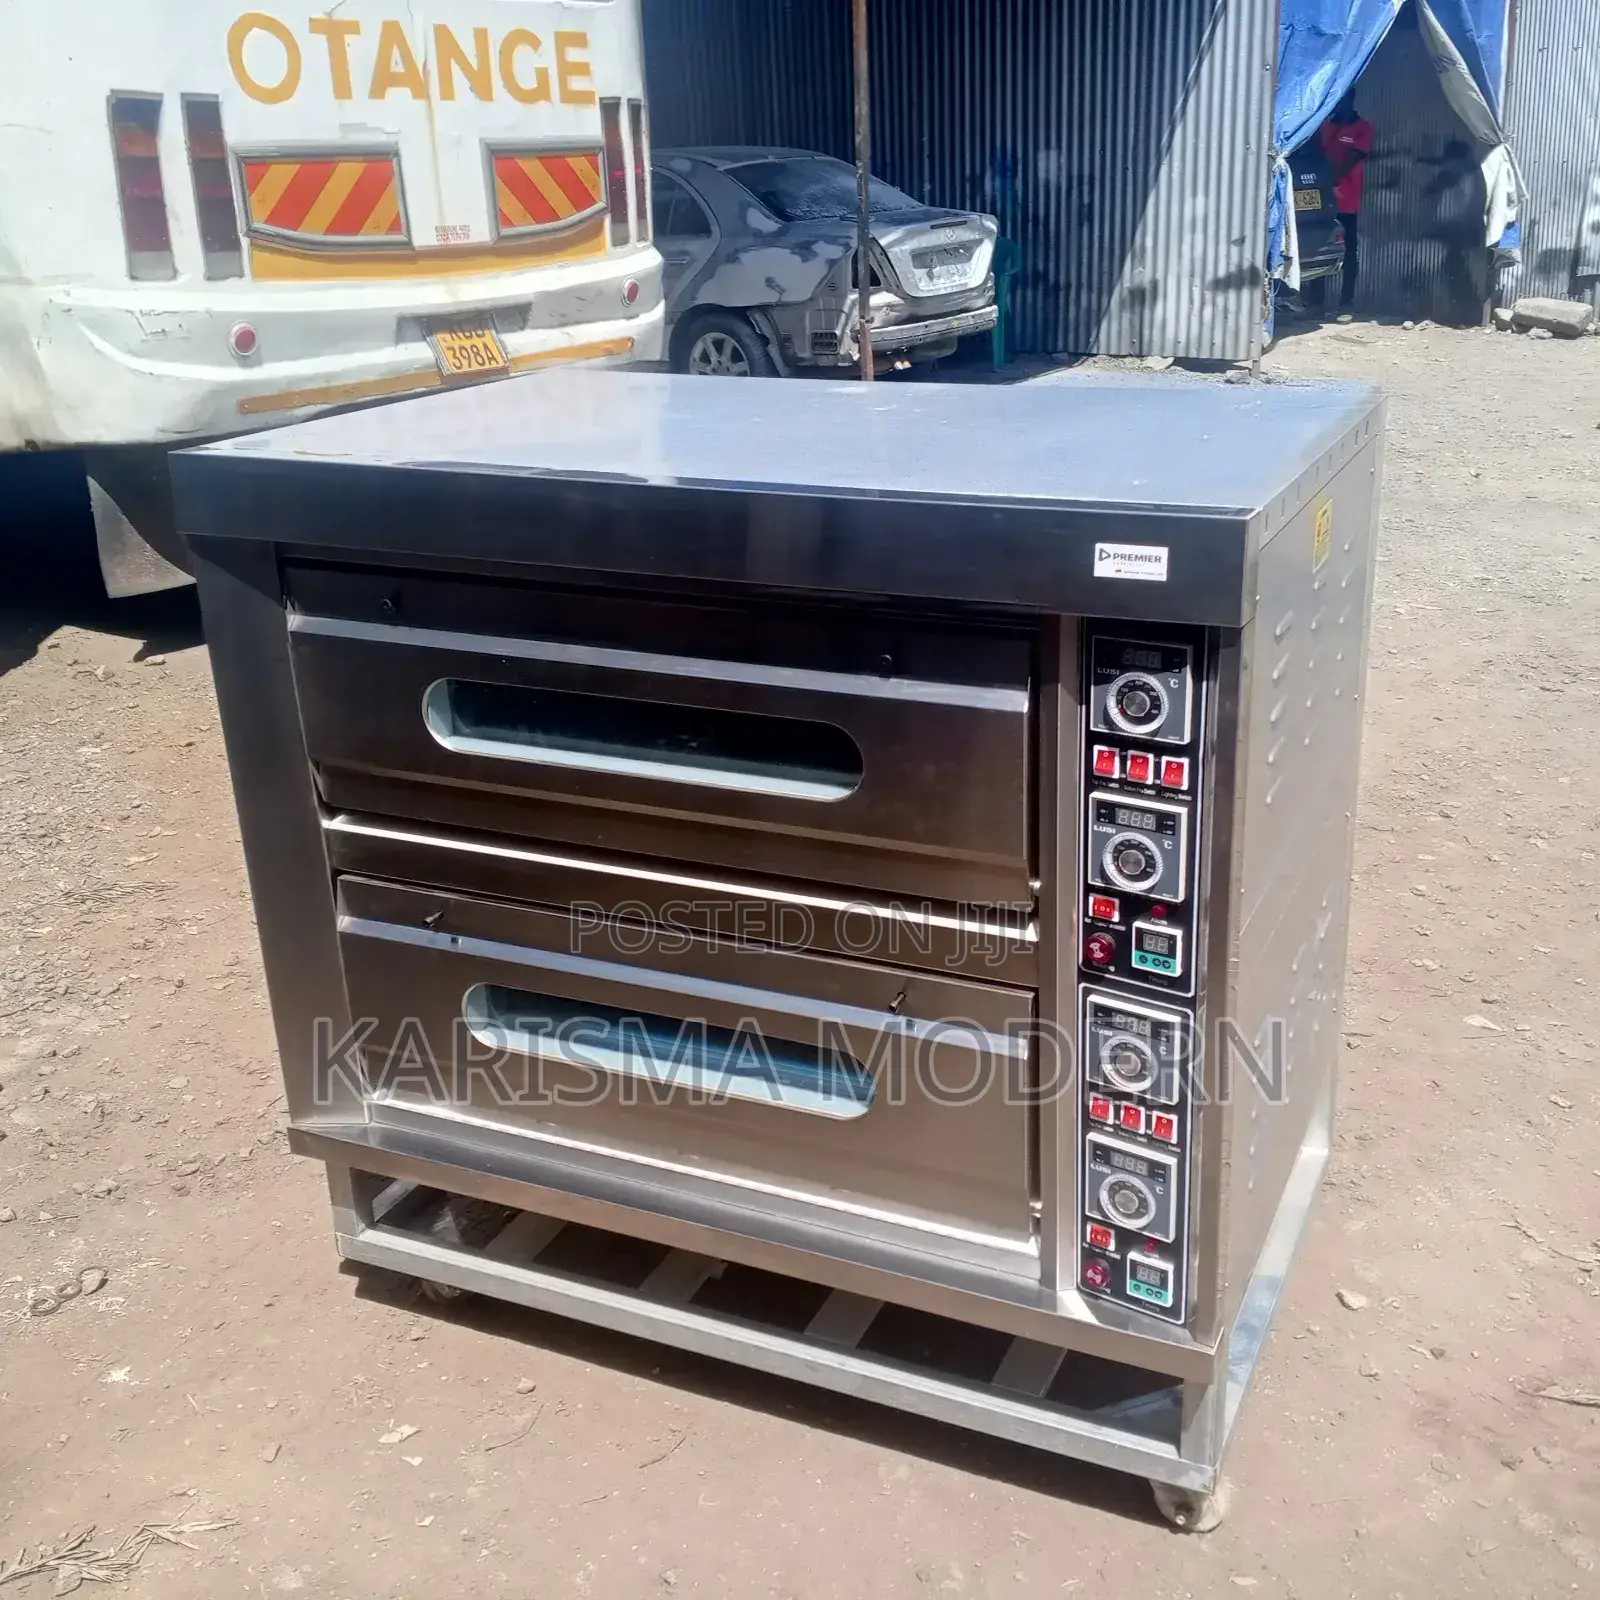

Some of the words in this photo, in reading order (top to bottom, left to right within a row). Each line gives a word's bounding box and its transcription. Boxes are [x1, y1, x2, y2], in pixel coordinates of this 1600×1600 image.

[227, 12, 596, 106] OTANGE
[445, 341, 499, 370] 398A
[1113, 552, 1162, 563] PREMIER
[1096, 667, 1120, 676] LUSI
[1093, 824, 1117, 834] LUSI
